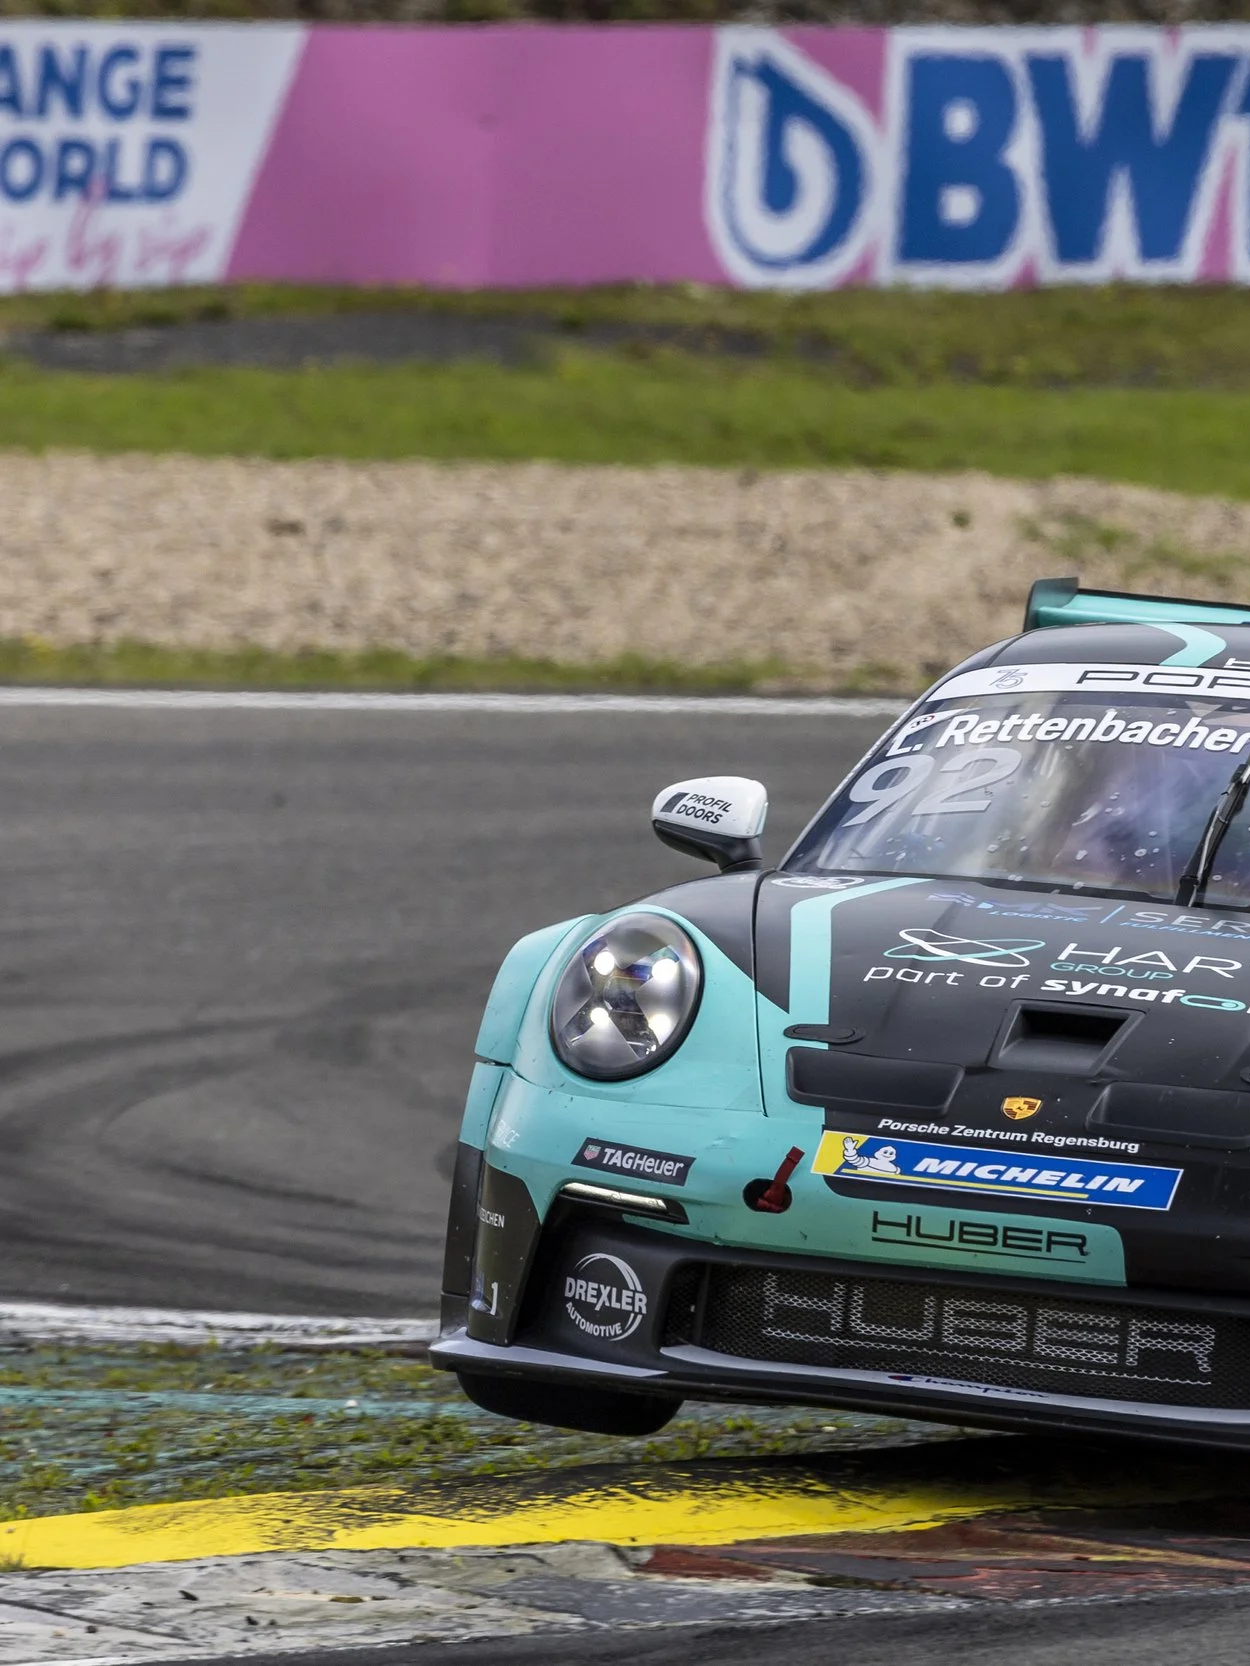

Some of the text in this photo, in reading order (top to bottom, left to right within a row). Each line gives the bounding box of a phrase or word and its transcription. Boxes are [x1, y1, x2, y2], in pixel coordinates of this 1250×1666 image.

[687, 794, 733, 813] PROFIL
[841, 748, 1022, 828] 92
[676, 804, 723, 824] DOORS
[863, 966, 964, 986] part
[979, 974, 1031, 989] of
[1050, 962, 1174, 981] GROUP
[878, 1119, 1140, 1154] Porsche Zentrum Regensburg
[912, 1157, 1145, 1193] MICHELIN
[872, 1211, 1089, 1256] HUBER
[564, 1276, 647, 1314] DREXLER
[565, 1302, 622, 1336] AUTOMOTIVE
[763, 1272, 1215, 1372] HUBER
